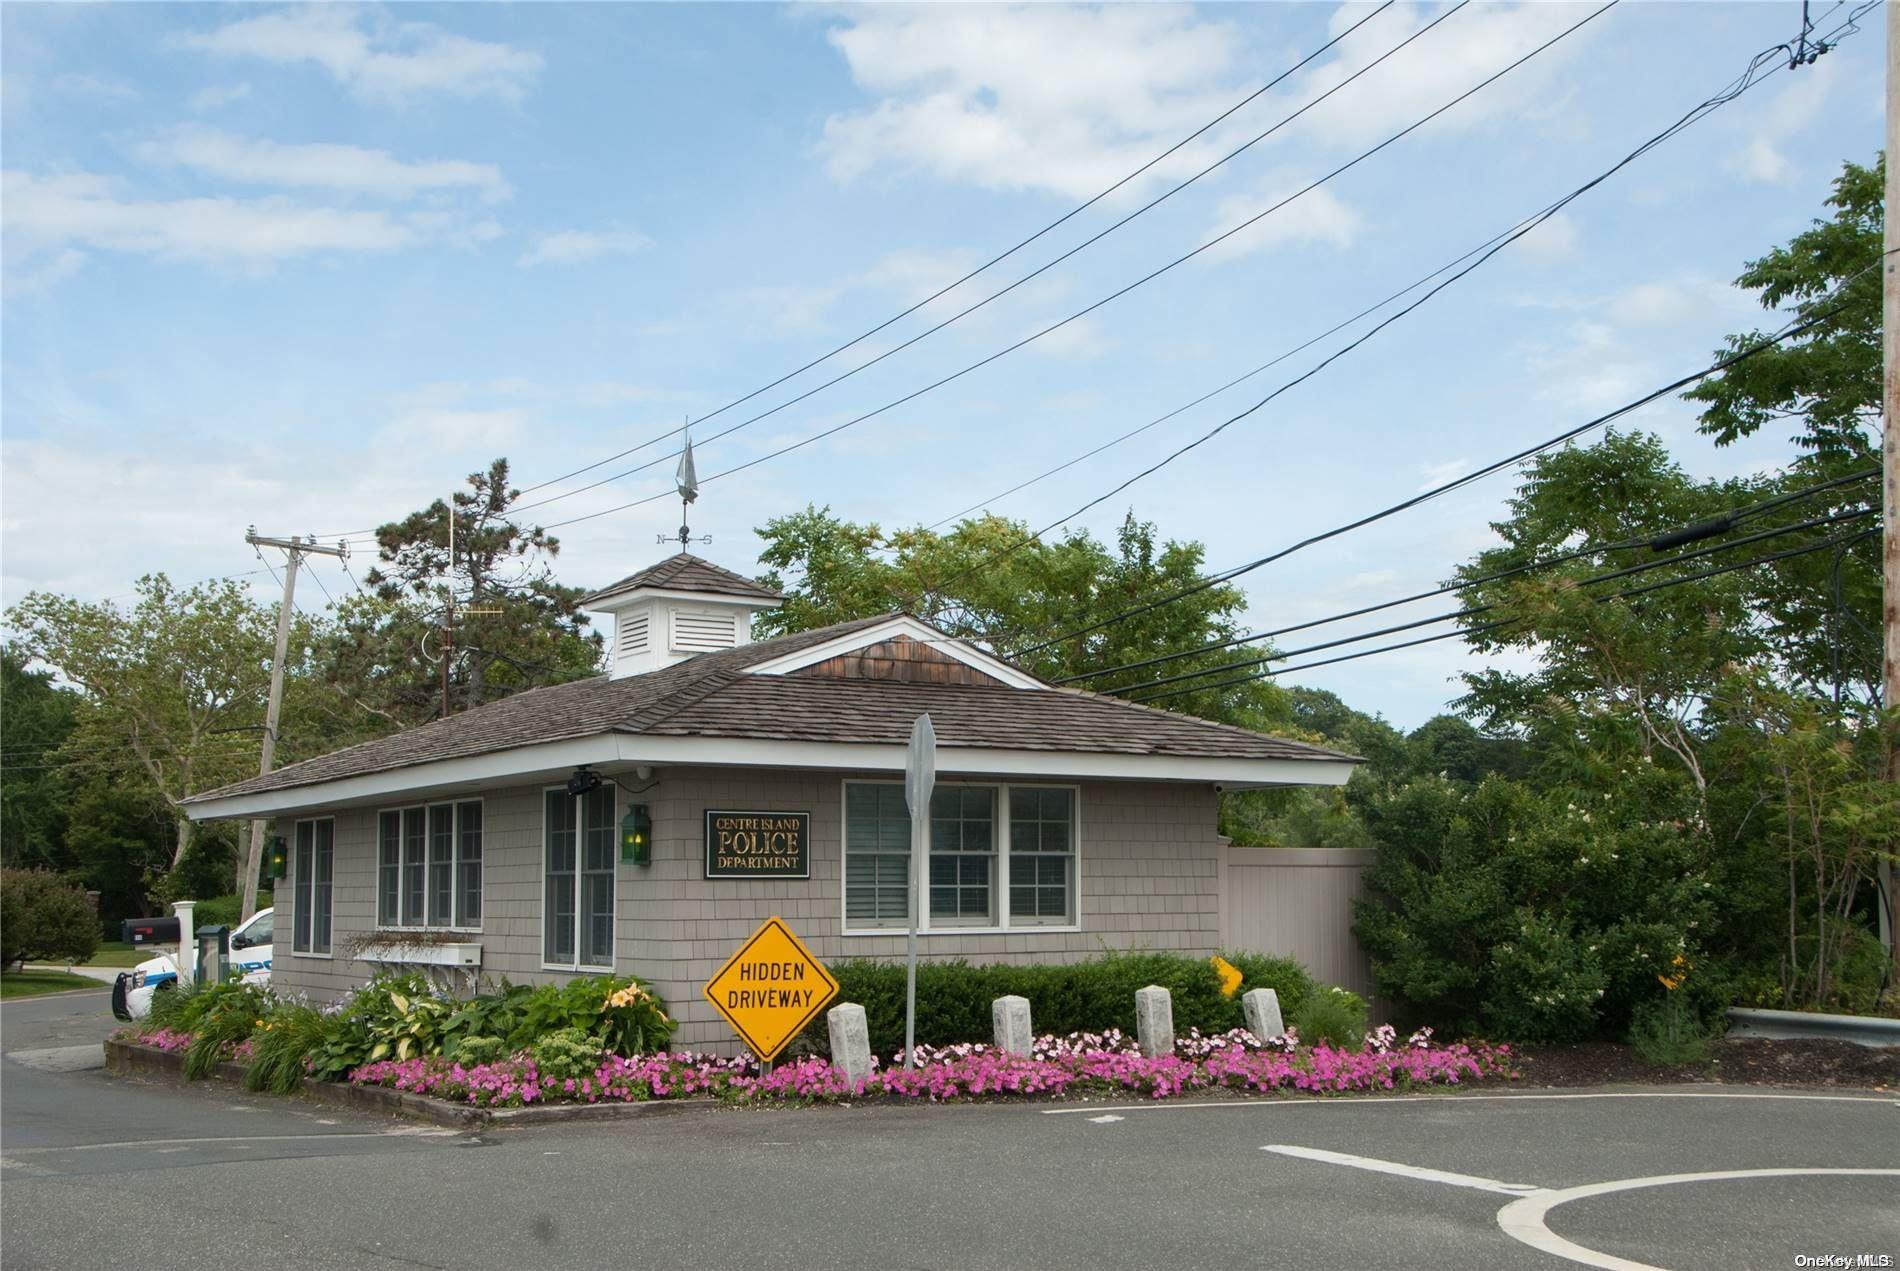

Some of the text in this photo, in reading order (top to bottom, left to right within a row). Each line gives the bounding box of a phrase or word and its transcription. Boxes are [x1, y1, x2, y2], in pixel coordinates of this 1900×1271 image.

[716, 818, 800, 830] CENTRE ISLAND
[718, 831, 799, 855] POLICE
[718, 856, 800, 869] DEPARTMENT
[740, 962, 804, 981] HIDDEN
[728, 989, 813, 1009] DRIVEWAY
